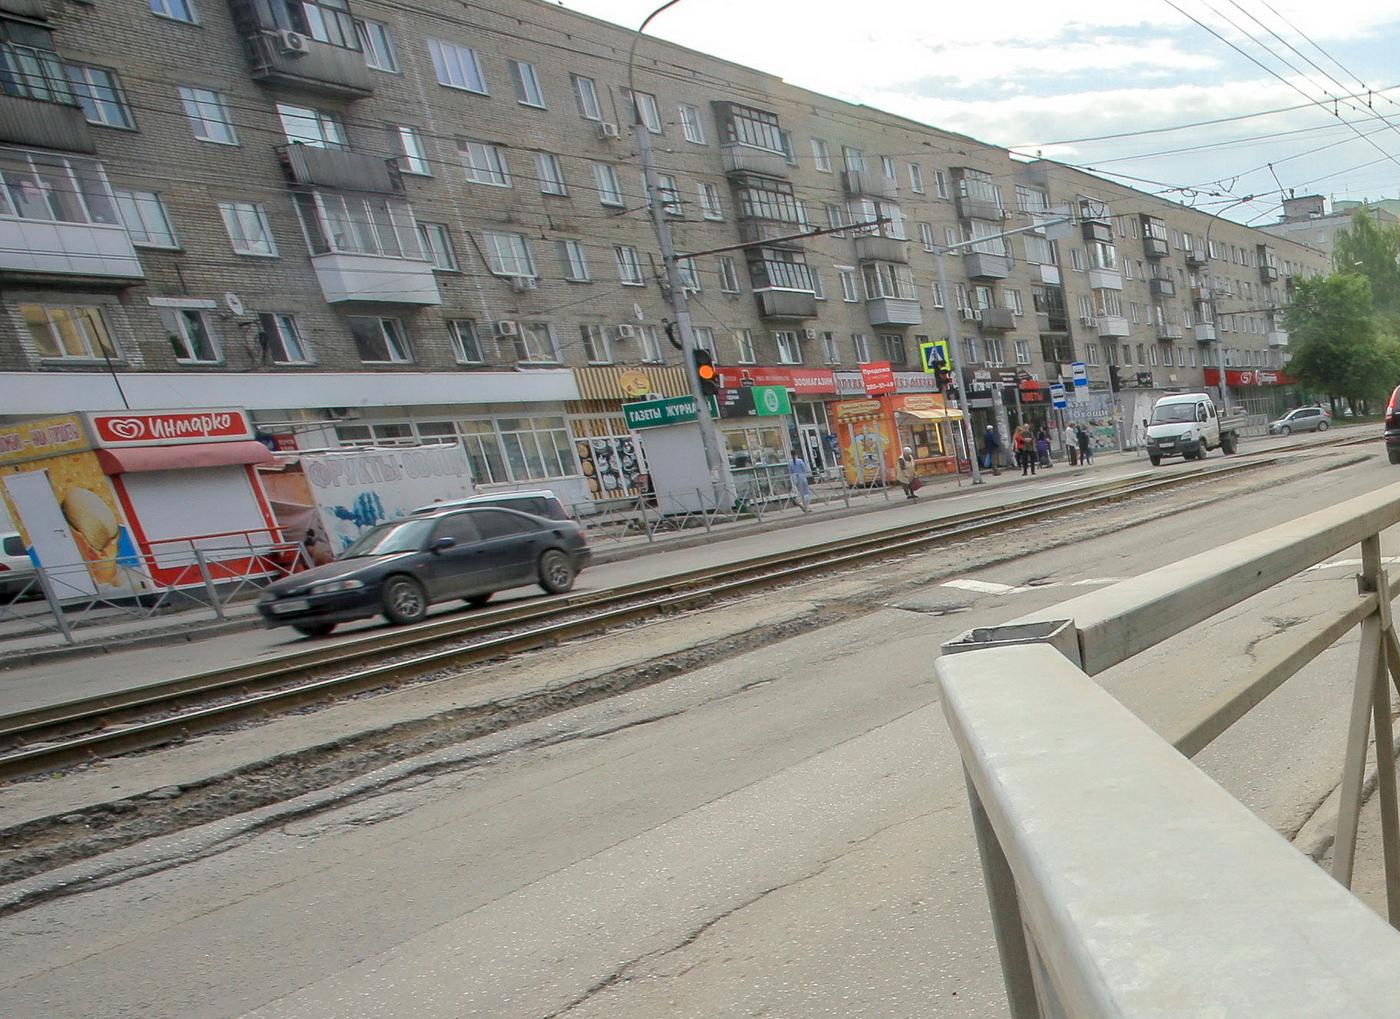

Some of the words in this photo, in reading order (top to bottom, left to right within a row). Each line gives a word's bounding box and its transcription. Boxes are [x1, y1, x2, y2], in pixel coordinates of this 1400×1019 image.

[793, 376, 834, 387] ЗООМАГАЗИН
[629, 408, 662, 422] ГАЗЕТЫ
[149, 413, 232, 438] Инмарко
[309, 455, 403, 488] ФРУКТЫ
